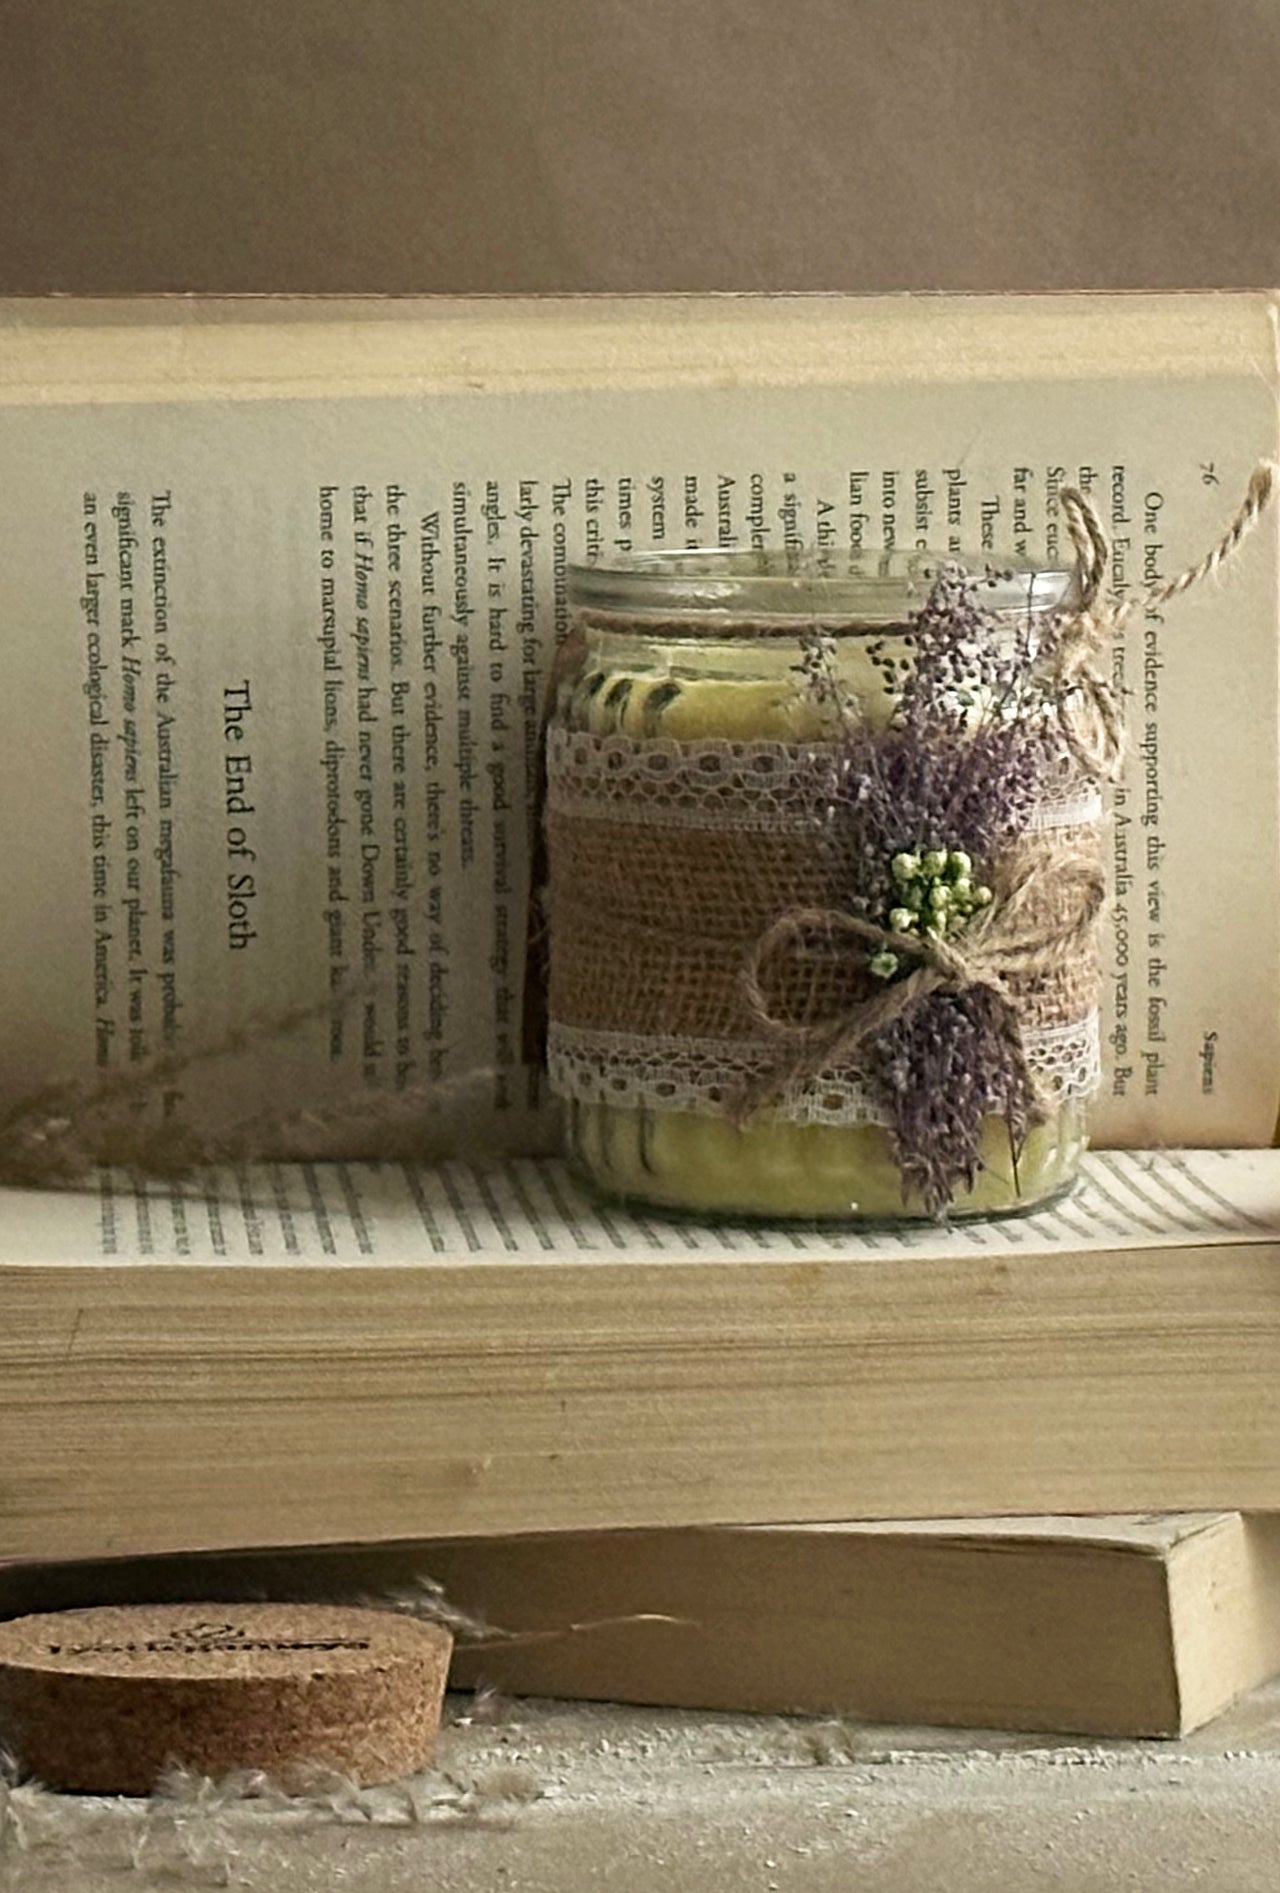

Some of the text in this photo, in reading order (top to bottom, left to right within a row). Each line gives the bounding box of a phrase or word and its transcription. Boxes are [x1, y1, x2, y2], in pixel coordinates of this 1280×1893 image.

[585, 479, 605, 514] this
[783, 473, 797, 482] a
[850, 471, 870, 507] lian
[1014, 467, 1034, 494] far
[1046, 466, 1066, 517] Since
[1079, 466, 1099, 494] the
[1200, 462, 1218, 485] 76
[86, 492, 100, 515] an
[152, 491, 172, 527] The
[320, 486, 341, 540] home
[354, 484, 375, 522] that
[388, 484, 408, 515] the
[483, 481, 509, 546] angles.
[515, 481, 540, 523] larly
[553, 480, 573, 517] The
[620, 478, 640, 529] times
[648, 477, 669, 539] system
[684, 476, 705, 527] made
[718, 475, 738, 549] Australi
[817, 500, 837, 515] A
[882, 471, 902, 552] into new
[915, 470, 935, 531] subsist
[943, 469, 968, 526] plants
[1014, 498, 1034, 534] and
[1111, 465, 1131, 529] record.
[1143, 492, 1163, 534] One
[86, 522, 101, 566] even
[114, 491, 141, 590] significant
[355, 531, 375, 550] if
[817, 520, 837, 548] thi
[981, 496, 1001, 550] These
[321, 549, 337, 569] to
[388, 523, 409, 572] three
[422, 512, 443, 596] Without
[489, 557, 509, 572] It
[1138, 543, 1164, 593] body
[82, 572, 108, 625] larger
[152, 536, 174, 634] extinction
[355, 553, 377, 611] Homo
[489, 583, 509, 597] is
[515, 526, 541, 634] devastating
[121, 598, 142, 649] mark
[317, 577, 344, 672] marsupial
[389, 580, 411, 672] scenarios.
[423, 605, 445, 672] further
[489, 607, 510, 652] hard
[154, 643, 175, 667] of
[352, 616, 378, 681] sapiens
[521, 638, 542, 666] for
[1144, 630, 1164, 712] evidence
[83, 632, 110, 726] ecological
[122, 656, 143, 714] Homo
[155, 673, 176, 704] the
[448, 481, 479, 870] simultaneously against multiple threats.
[490, 662, 505, 682] to
[517, 670, 542, 716] large
[320, 680, 345, 732] lions,
[358, 687, 379, 724] had
[391, 681, 412, 716] But
[490, 693, 511, 731] find
[392, 724, 413, 772] there
[422, 682, 446, 772] evidence,
[491, 742, 505, 752] a
[87, 733, 112, 807] disaster,
[118, 719, 145, 782] sapiens
[156, 711, 177, 809] Australian
[359, 731, 374, 780] never
[1139, 721, 1164, 826] supporting
[125, 788, 146, 820] left
[320, 740, 347, 858] diprotodons
[393, 781, 407, 810] are
[426, 781, 447, 840] there's
[486, 763, 512, 812] good
[1112, 788, 1132, 807] in
[92, 814, 113, 849] this
[224, 681, 257, 950] The End of Sloth
[355, 788, 375, 836] gone
[126, 826, 140, 852] on
[388, 817, 415, 900] certainly
[492, 821, 513, 894] survival
[1112, 813, 1133, 896] Australia
[1144, 836, 1165, 870] this
[93, 855, 114, 899] time
[126, 858, 141, 892] our
[153, 820, 179, 920] megafauna
[327, 866, 348, 902] and
[361, 843, 382, 903] Down
[427, 851, 442, 877] no
[94, 904, 114, 923] in
[423, 886, 443, 923] way
[1144, 880, 1165, 922] view
[122, 898, 149, 961] planet.
[160, 930, 174, 964] was
[323, 910, 349, 957] giant
[390, 908, 416, 956] good
[429, 933, 449, 955] of
[488, 904, 509, 975] strategy
[1109, 902, 1129, 967] 45,000
[1145, 933, 1165, 947] is
[129, 968, 149, 984] It
[1108, 971, 1128, 1018] years
[1145, 957, 1165, 987] the
[129, 989, 144, 1022] was
[396, 963, 411, 1030] reasons
[424, 962, 450, 1040] deciding
[494, 986, 514, 1023] that
[1145, 996, 1165, 1042] fossil
[397, 1037, 413, 1054] to
[1108, 1023, 1128, 1060] ago.
[1198, 1031, 1219, 1095] Sapiens
[1114, 1067, 1134, 1097] But
[1140, 1051, 1165, 1096] plant
